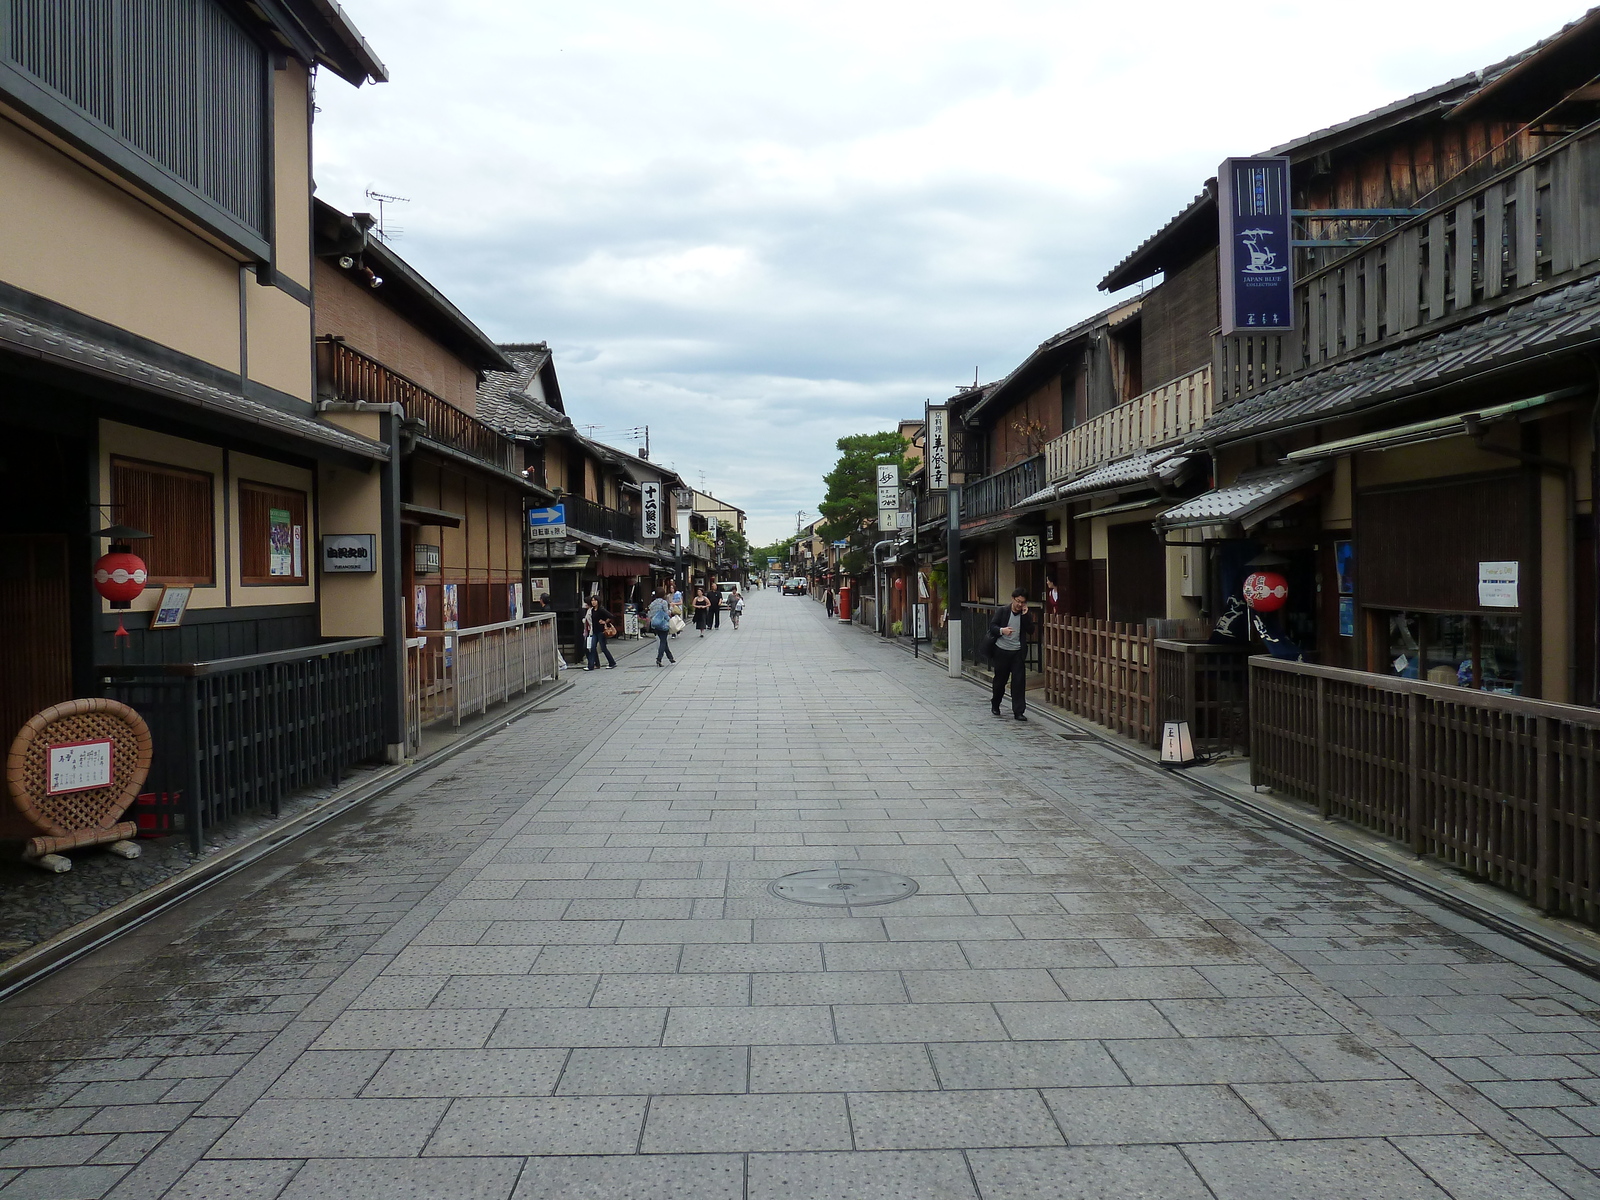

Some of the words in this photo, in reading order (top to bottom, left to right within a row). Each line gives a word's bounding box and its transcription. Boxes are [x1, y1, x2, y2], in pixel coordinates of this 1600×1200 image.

[934, 411, 943, 434] 京料理
[644, 485, 657, 535] 十二段家
[532, 527, 565, 537] 自転車を除く
